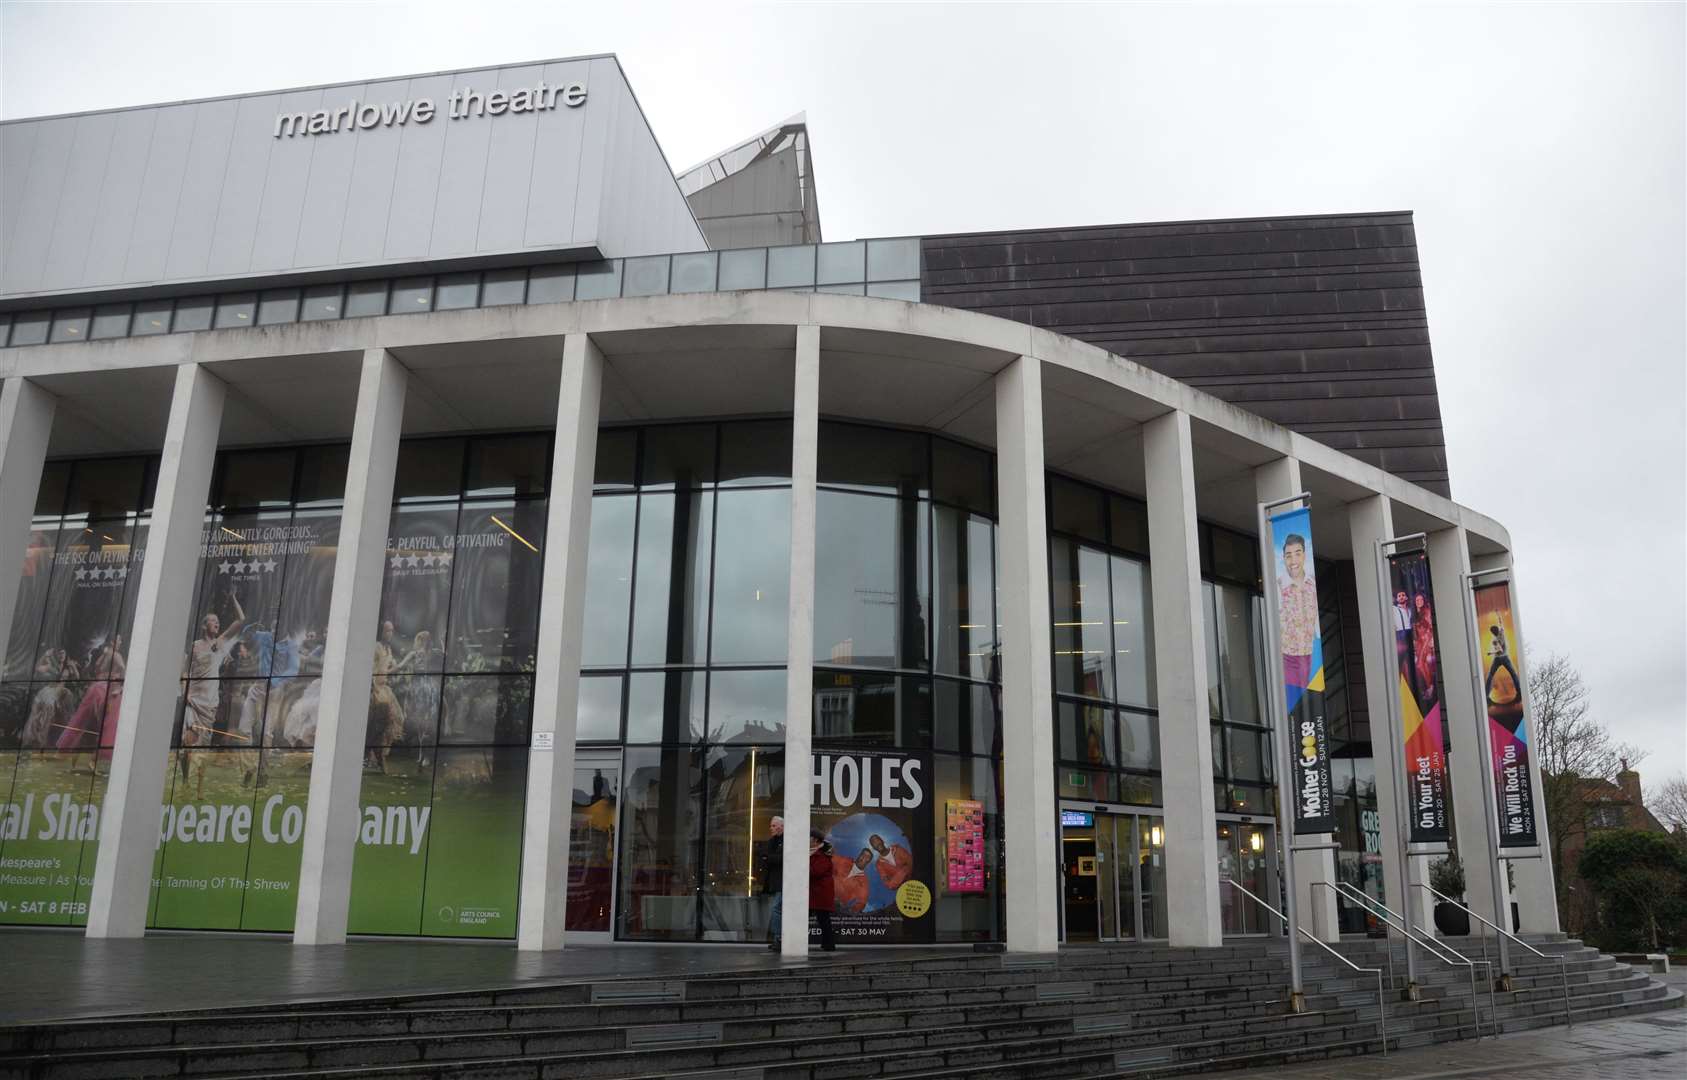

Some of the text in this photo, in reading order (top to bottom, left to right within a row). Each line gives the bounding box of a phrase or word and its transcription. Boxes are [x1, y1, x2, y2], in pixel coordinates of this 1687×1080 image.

[273, 80, 587, 138] marlowe theatre
[810, 755, 923, 808] HOLES
[1302, 769, 1321, 818] Mother
[1320, 768, 1328, 786] NOV
[1416, 756, 1435, 828] On Your Feet
[1434, 768, 1440, 777] 25
[1503, 745, 1523, 834] We Will Rock You
[0, 793, 34, 840] al
[1437, 799, 1443, 808] 20
[167, 877, 207, 889] Taming
[211, 877, 227, 888] Of
[229, 877, 250, 889] The
[254, 878, 290, 890] Shrew
[20, 901, 47, 912] SAT
[48, 902, 57, 914] 8
[60, 902, 87, 914] FEB
